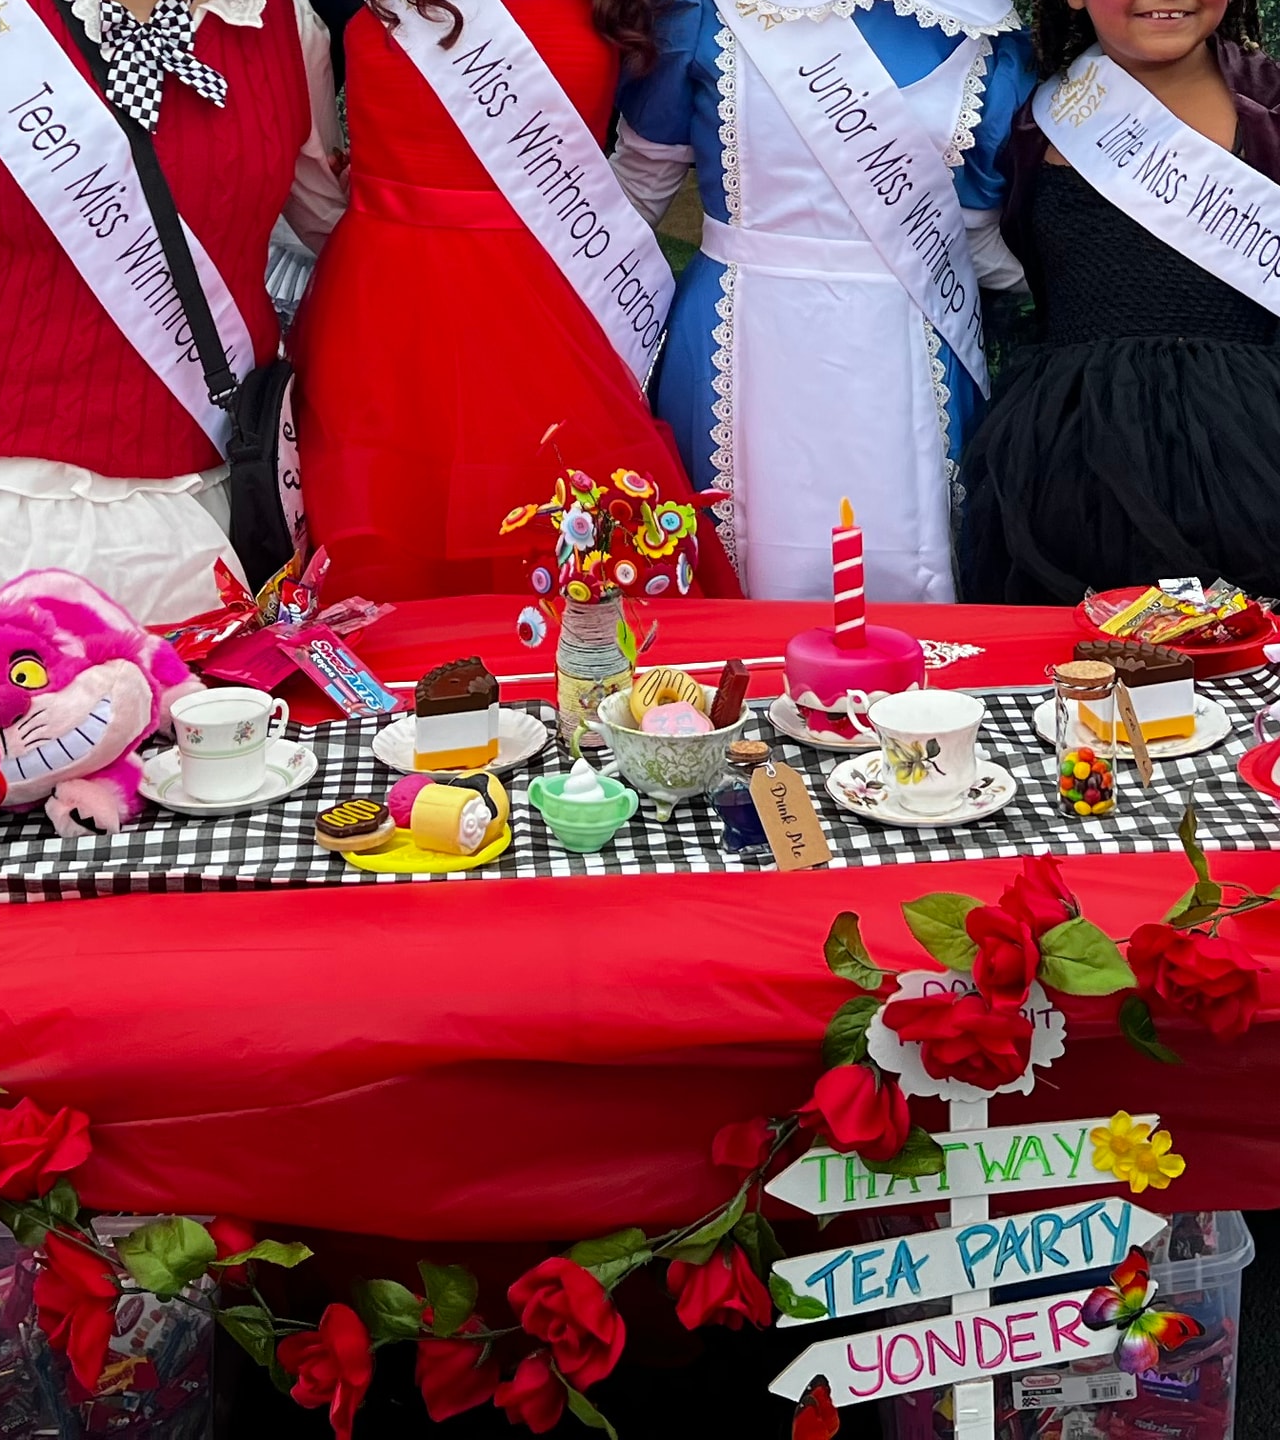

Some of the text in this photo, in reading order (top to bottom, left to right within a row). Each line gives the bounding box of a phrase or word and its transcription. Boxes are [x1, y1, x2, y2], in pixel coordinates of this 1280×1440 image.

[452, 38, 518, 118] Miss
[507, 110, 610, 259] Winthrop
[1069, 83, 1107, 128] 2024
[8, 81, 81, 173] Teen
[64, 162, 129, 239] Miss
[799, 52, 877, 143] Junior
[857, 137, 913, 207] Miss
[900, 191, 965, 315] Winthrop
[1096, 113, 1149, 168] Little
[1134, 140, 1188, 205] Miss
[310, 652, 337, 678] Ropes
[770, 782, 807, 859] Drink Me
[973, 1127, 1088, 1184] WAY
[805, 1202, 1133, 1320] TEA PARTY
[847, 1300, 1091, 1396] YONDER
